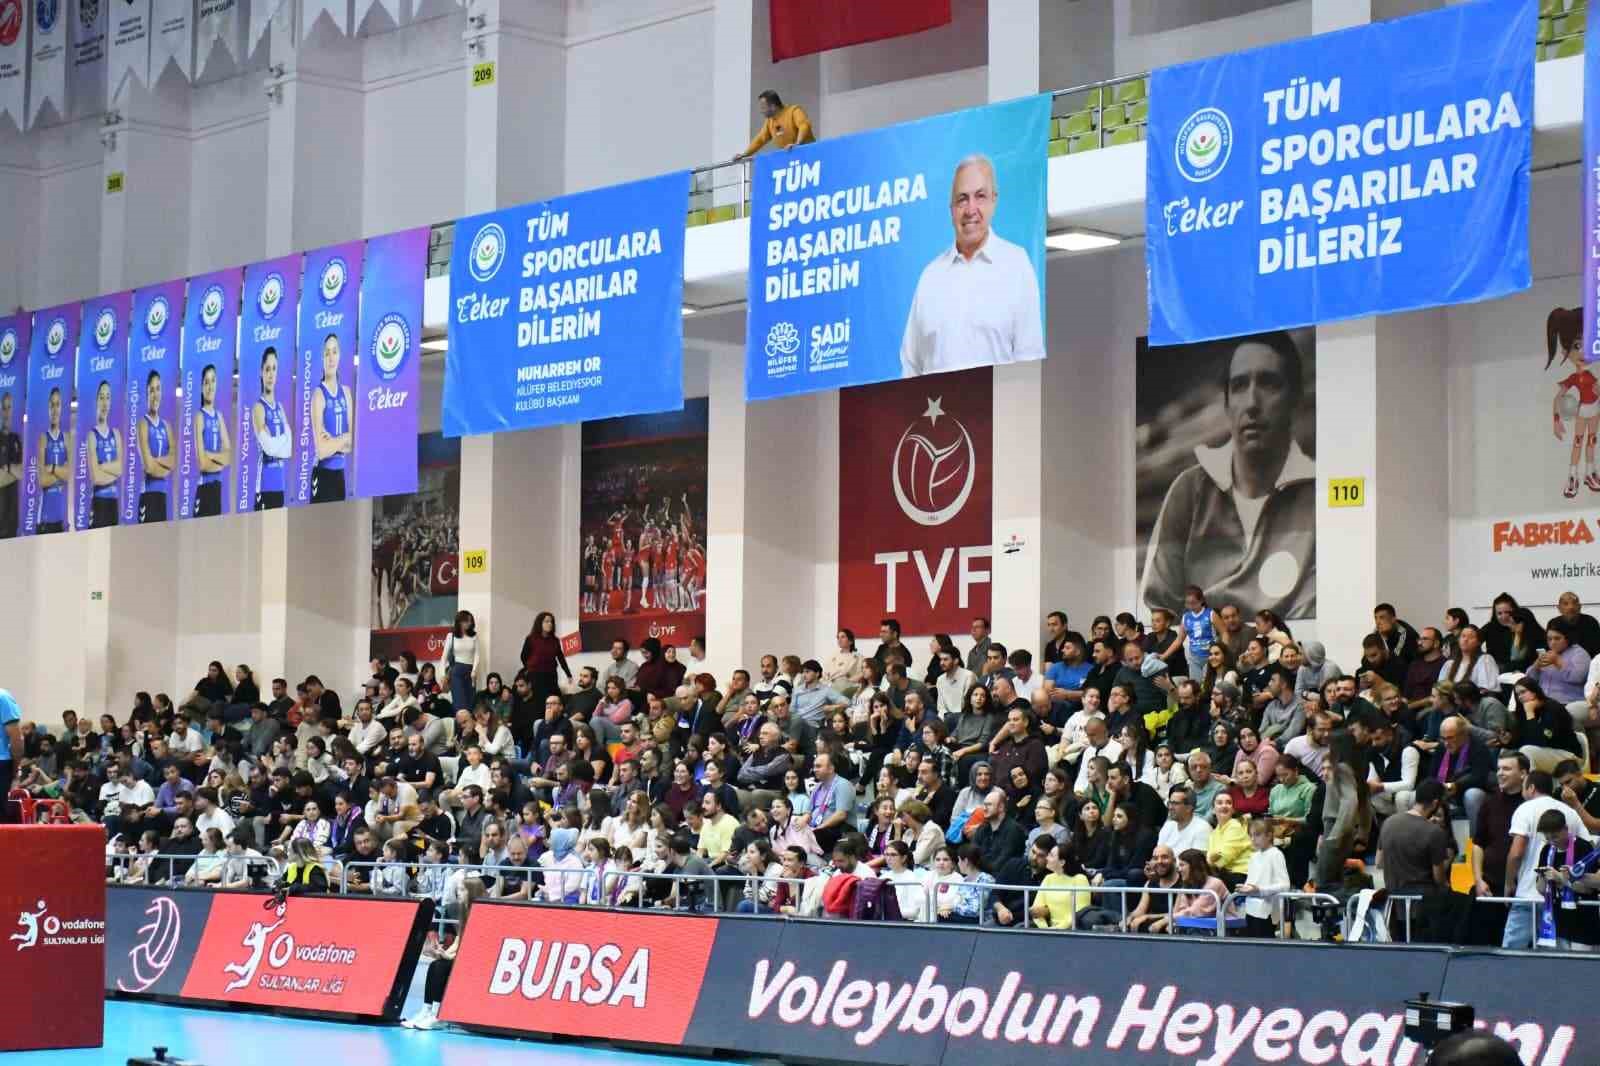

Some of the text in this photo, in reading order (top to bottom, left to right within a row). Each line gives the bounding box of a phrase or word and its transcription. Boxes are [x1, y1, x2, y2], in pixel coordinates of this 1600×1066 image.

[474, 68, 492, 82] 209
[1263, 76, 1341, 125] TÜM
[1261, 91, 1521, 175] SPORCULARA
[772, 159, 821, 195] TÜM
[1259, 152, 1478, 225] BAŞARILAR
[768, 173, 928, 231] SPORCULARA
[527, 211, 569, 242] TÜM
[766, 216, 901, 267] BAŞARILAR
[1258, 212, 1403, 275] DİLERİZ
[521, 228, 662, 278] SPORCULARA
[519, 268, 638, 313] BAŞARILAR
[765, 257, 860, 303] DİLERİM
[517, 307, 601, 348] DİLERİM
[517, 356, 601, 382] MUHARREM OR
[180, 371, 193, 516] Buse Ünal Pehlivan
[298, 350, 311, 500] Polina Shemanova
[240, 405, 251, 509] Burcu Yönder
[25, 498, 35, 530] Nina
[76, 483, 86, 528] Merve
[1332, 485, 1359, 500] 110
[465, 556, 483, 569] 109
[874, 545, 992, 614] TVF
[661, 626, 677, 636] TVF
[43, 937, 87, 946] SULTANLAR
[62, 919, 105, 930] vodafone
[296, 943, 356, 964] vodafone
[489, 937, 650, 1009] BURSA
[746, 958, 1101, 1048] Voleybolun
